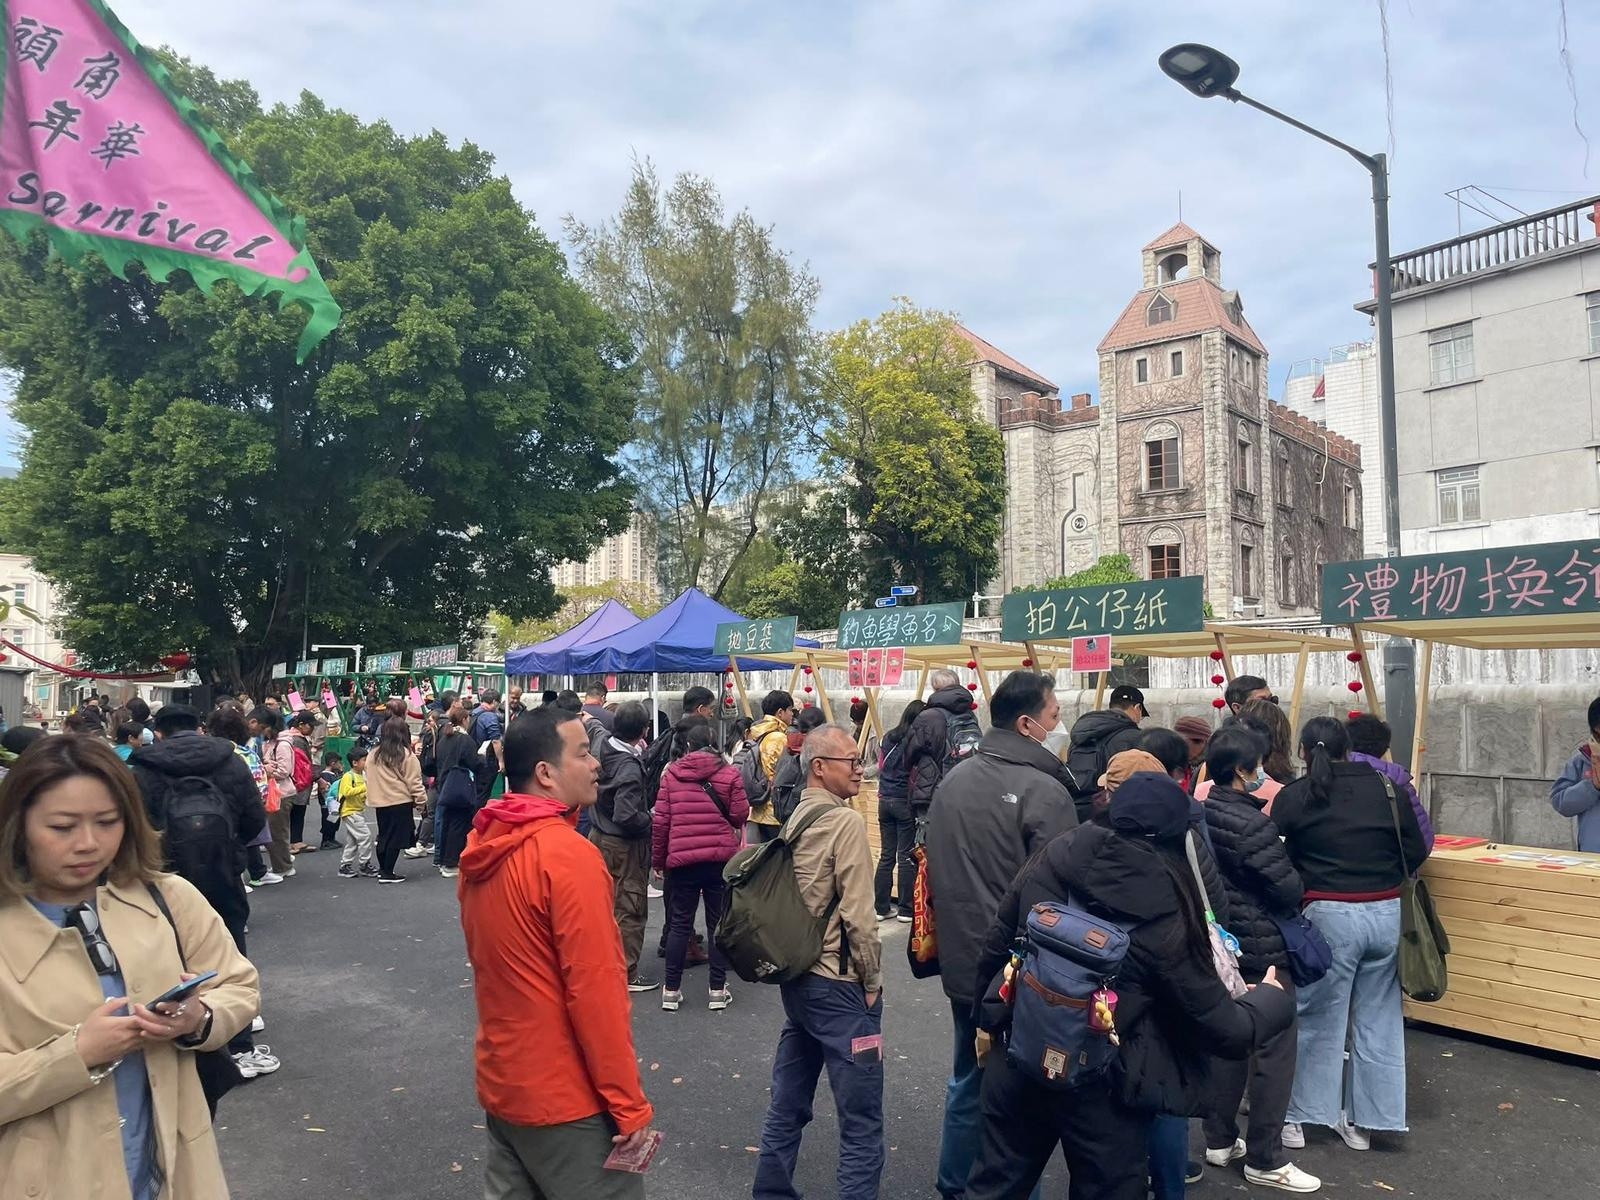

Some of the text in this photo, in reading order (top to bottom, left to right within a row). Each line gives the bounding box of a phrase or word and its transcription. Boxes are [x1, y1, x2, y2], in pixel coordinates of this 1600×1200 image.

[842, 611, 937, 646] 釣魚學魚名
[1025, 588, 1168, 634] 拍公仔紙
